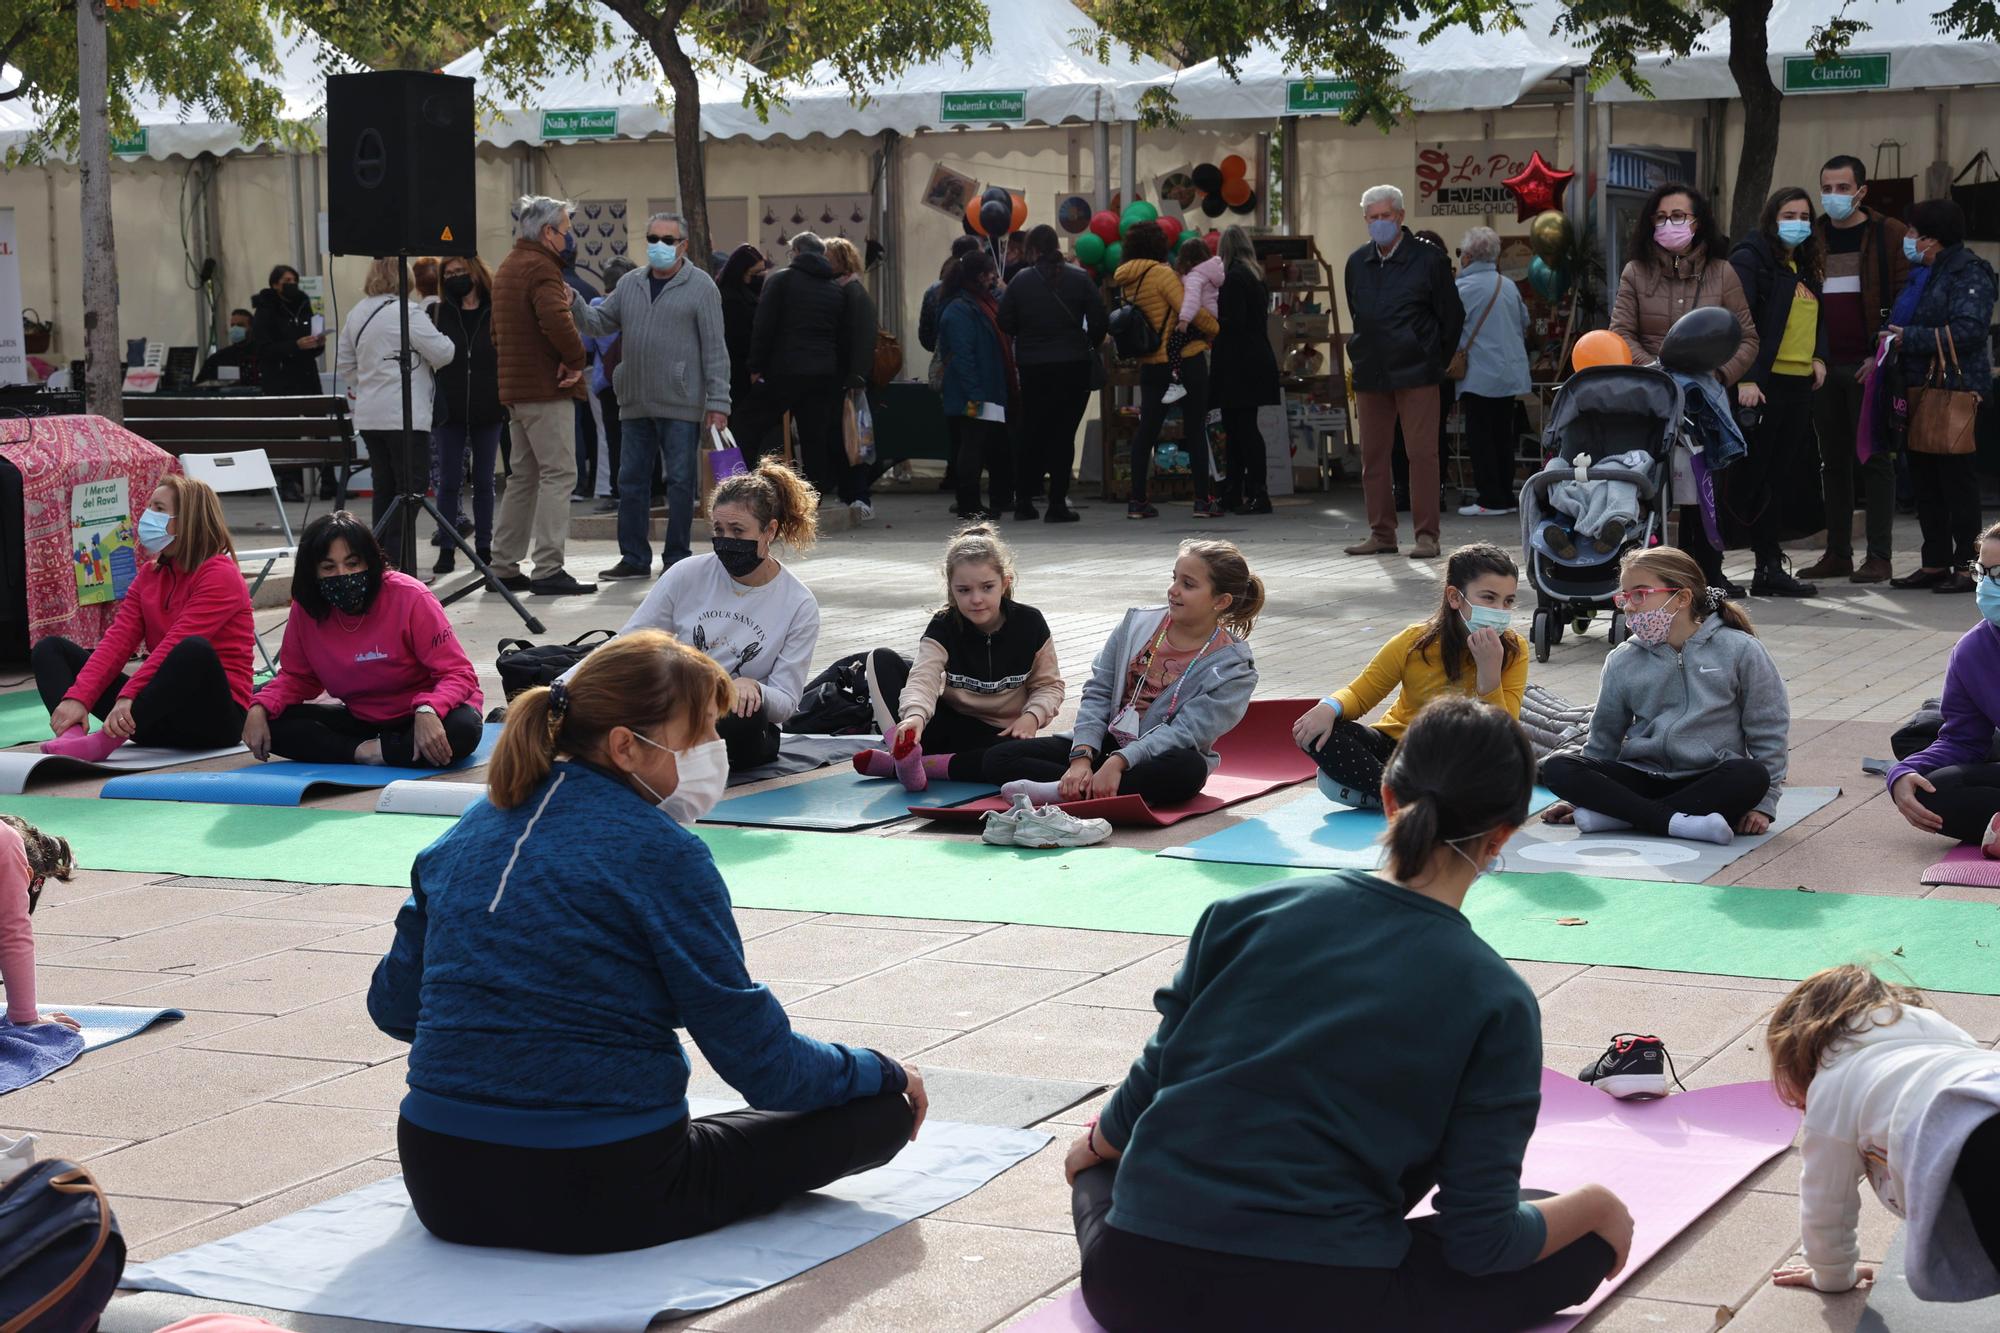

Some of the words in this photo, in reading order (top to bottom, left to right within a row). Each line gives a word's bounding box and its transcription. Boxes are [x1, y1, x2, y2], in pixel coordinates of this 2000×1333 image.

[1811, 65, 1862, 80] Clarión
[1303, 88, 1319, 101] La
[945, 100, 987, 112] Academia
[546, 117, 567, 130] Nails
[570, 117, 579, 131] by
[581, 116, 614, 129] Rosabel
[1451, 155, 1484, 183] La
[1488, 154, 1525, 178] Peo
[1448, 188, 1517, 202] EVENTO
[1431, 202, 1518, 216] DETALLES-CHUCH
[90, 483, 116, 496] Mercat
[83, 499, 95, 508] del
[97, 495, 118, 507] Raval
[732, 612, 754, 628] SANS
[753, 624, 767, 642] FIN
